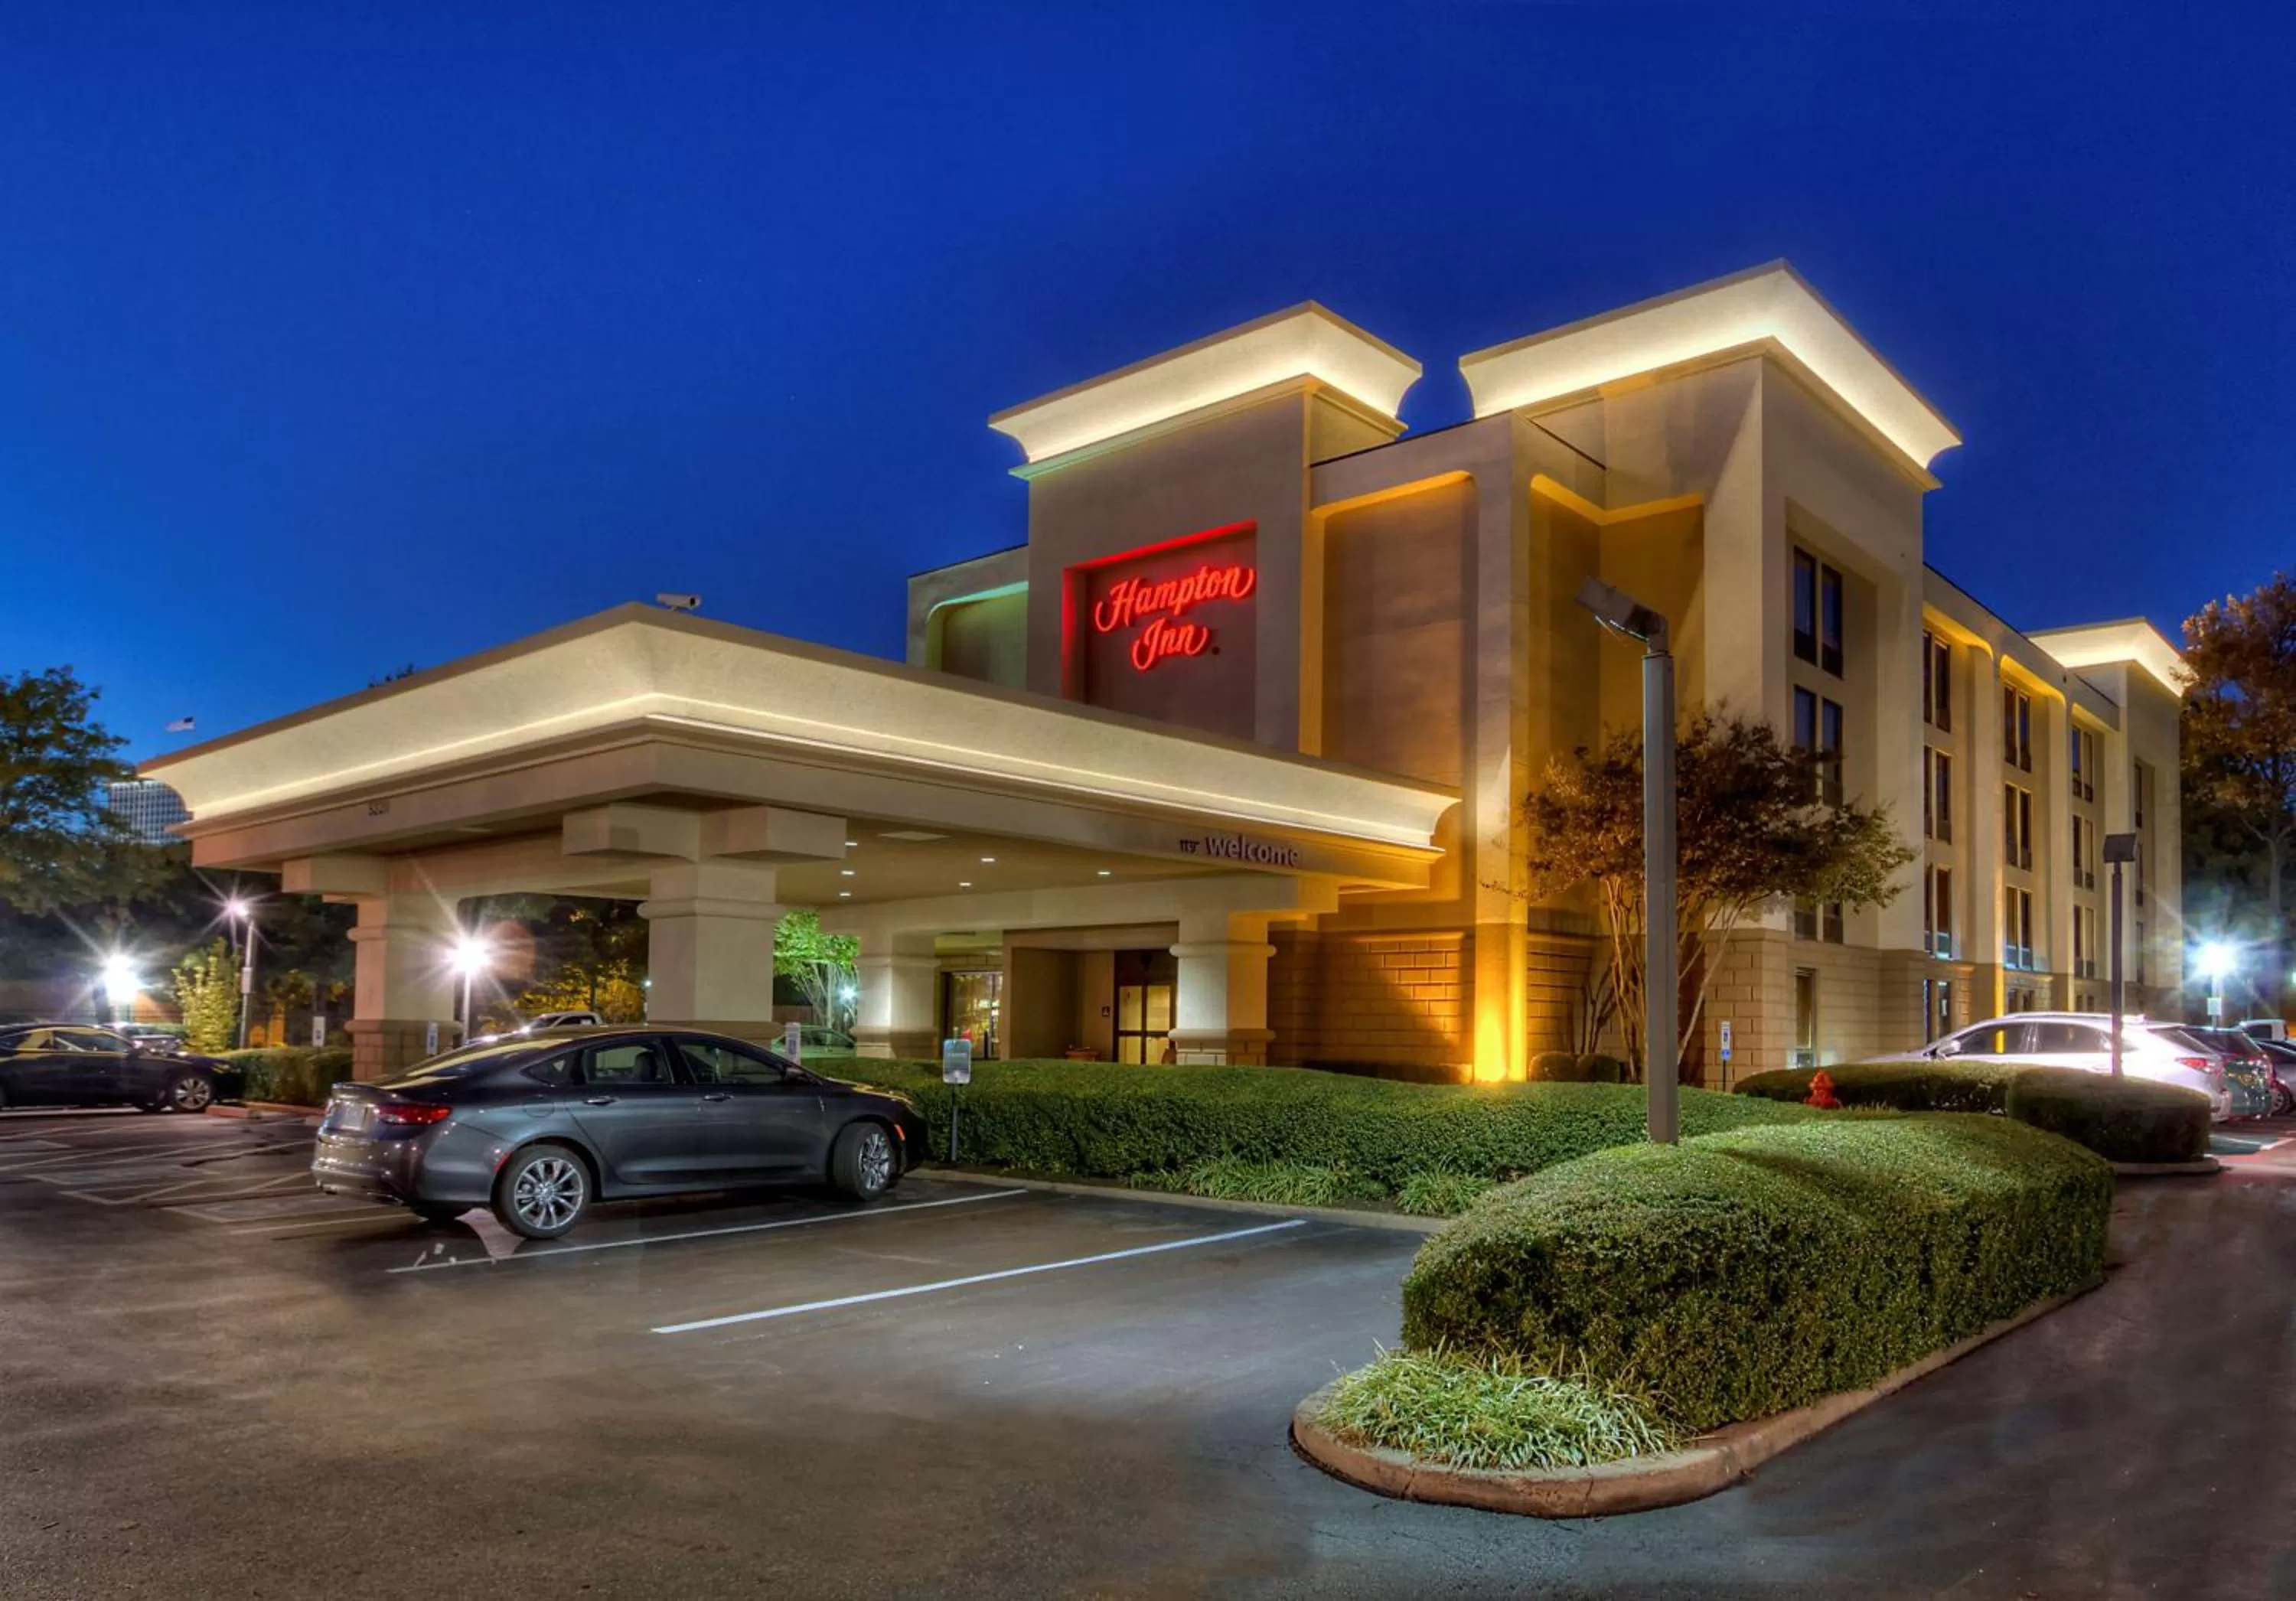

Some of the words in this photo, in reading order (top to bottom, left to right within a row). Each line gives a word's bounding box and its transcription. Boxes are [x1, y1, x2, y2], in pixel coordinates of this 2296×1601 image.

[1094, 565, 1256, 632] Hampton
[1131, 617, 1209, 671] Inn
[1205, 833, 1300, 867] Welcome
